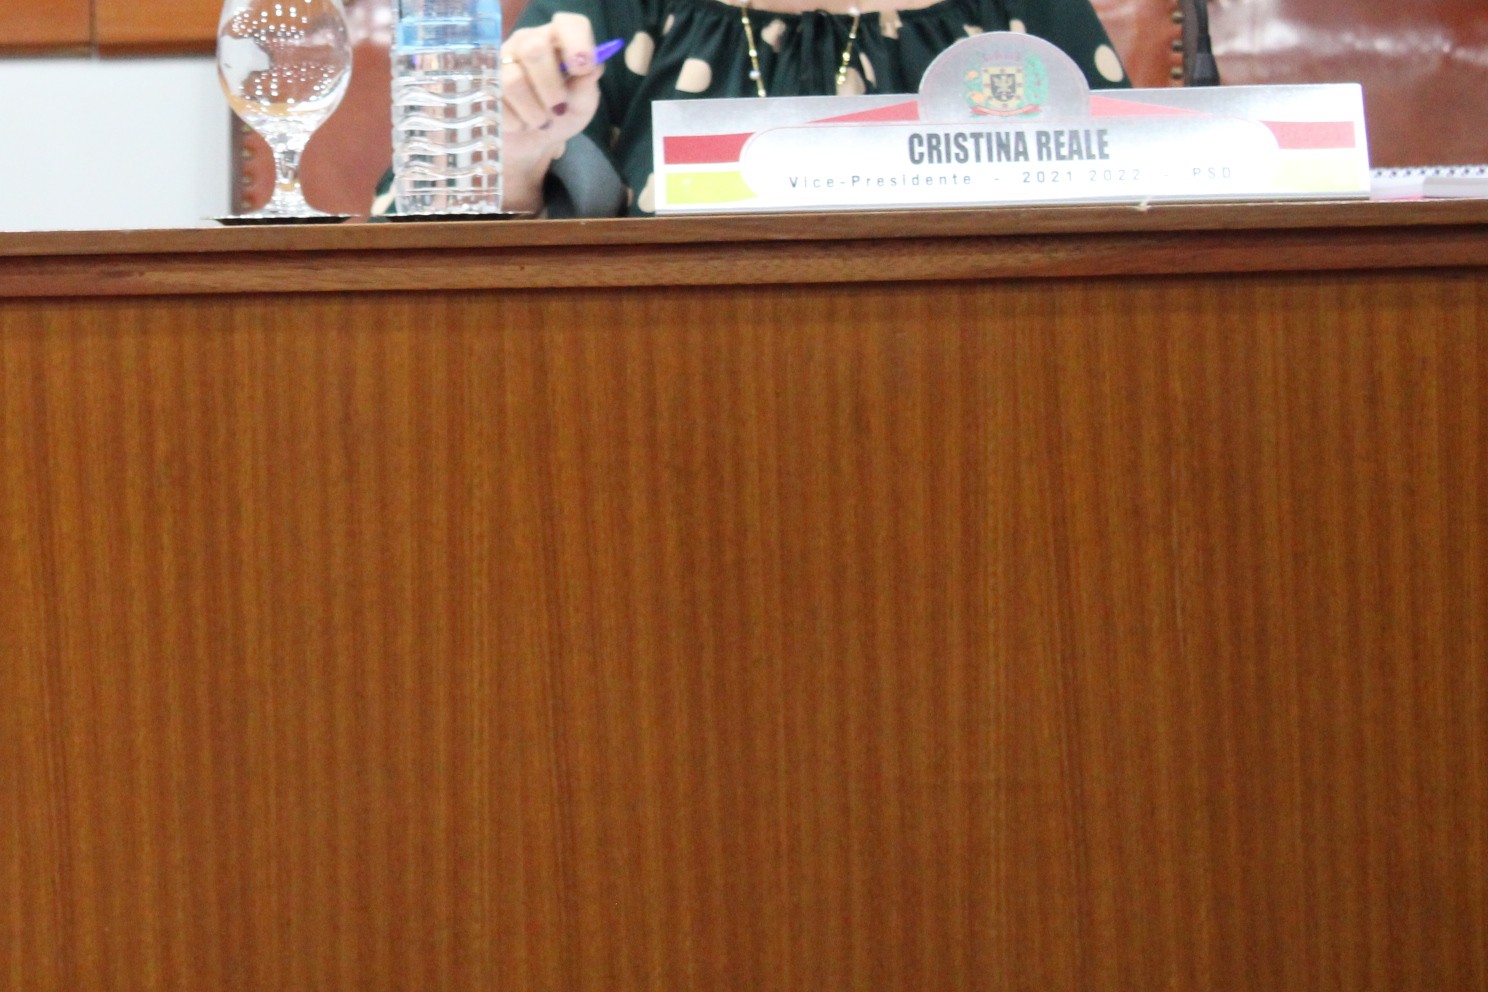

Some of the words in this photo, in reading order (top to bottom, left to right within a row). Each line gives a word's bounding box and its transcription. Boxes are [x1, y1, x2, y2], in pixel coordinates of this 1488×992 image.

[908, 131, 1029, 165] CRISTINA
[1036, 128, 1110, 161] REALE
[789, 173, 972, 188] Vice-Presidente
